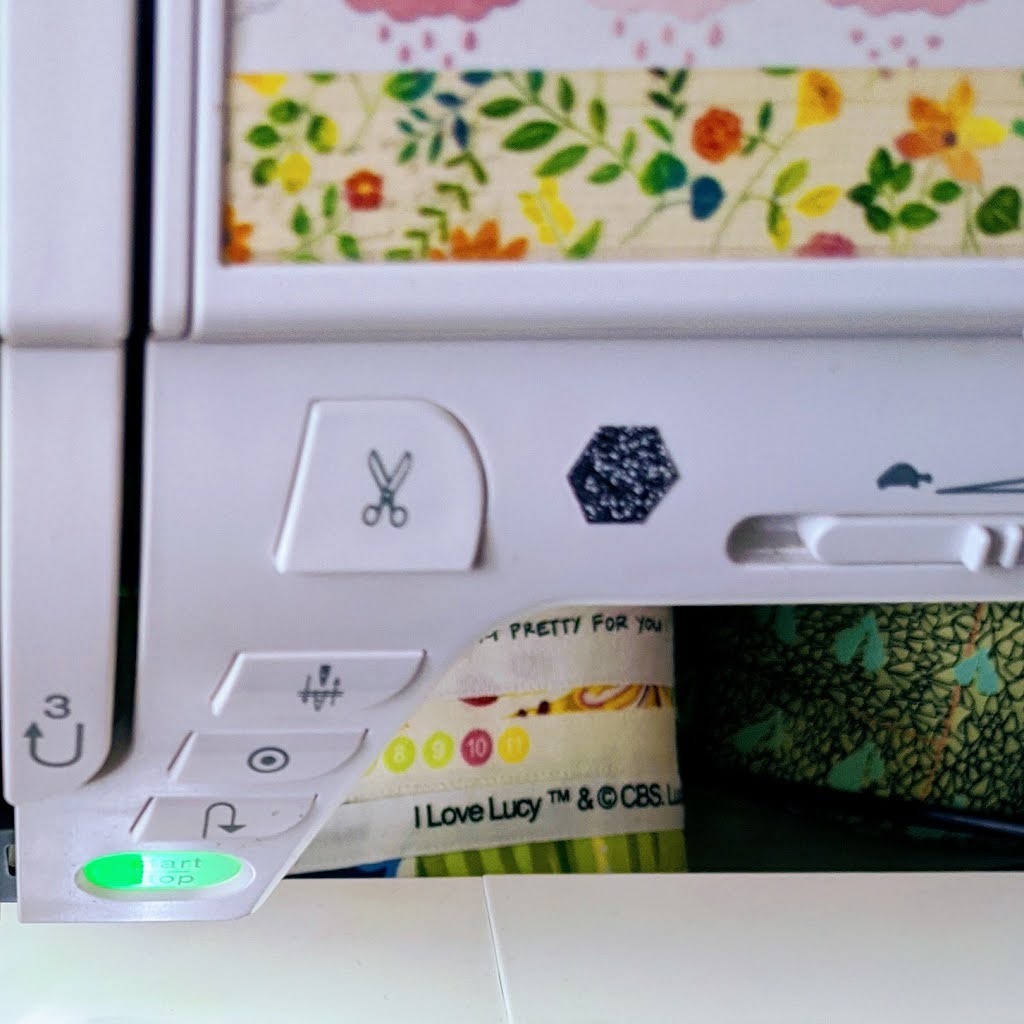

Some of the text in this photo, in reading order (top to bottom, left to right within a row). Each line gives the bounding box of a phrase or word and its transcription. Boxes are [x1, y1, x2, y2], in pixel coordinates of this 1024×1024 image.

[509, 615, 582, 641] PRETTY
[592, 612, 629, 633] FOR
[635, 615, 662, 634] YOU
[43, 694, 71, 720] 3
[413, 805, 422, 829] I
[426, 803, 484, 829] Love
[488, 796, 543, 824] Lucy
